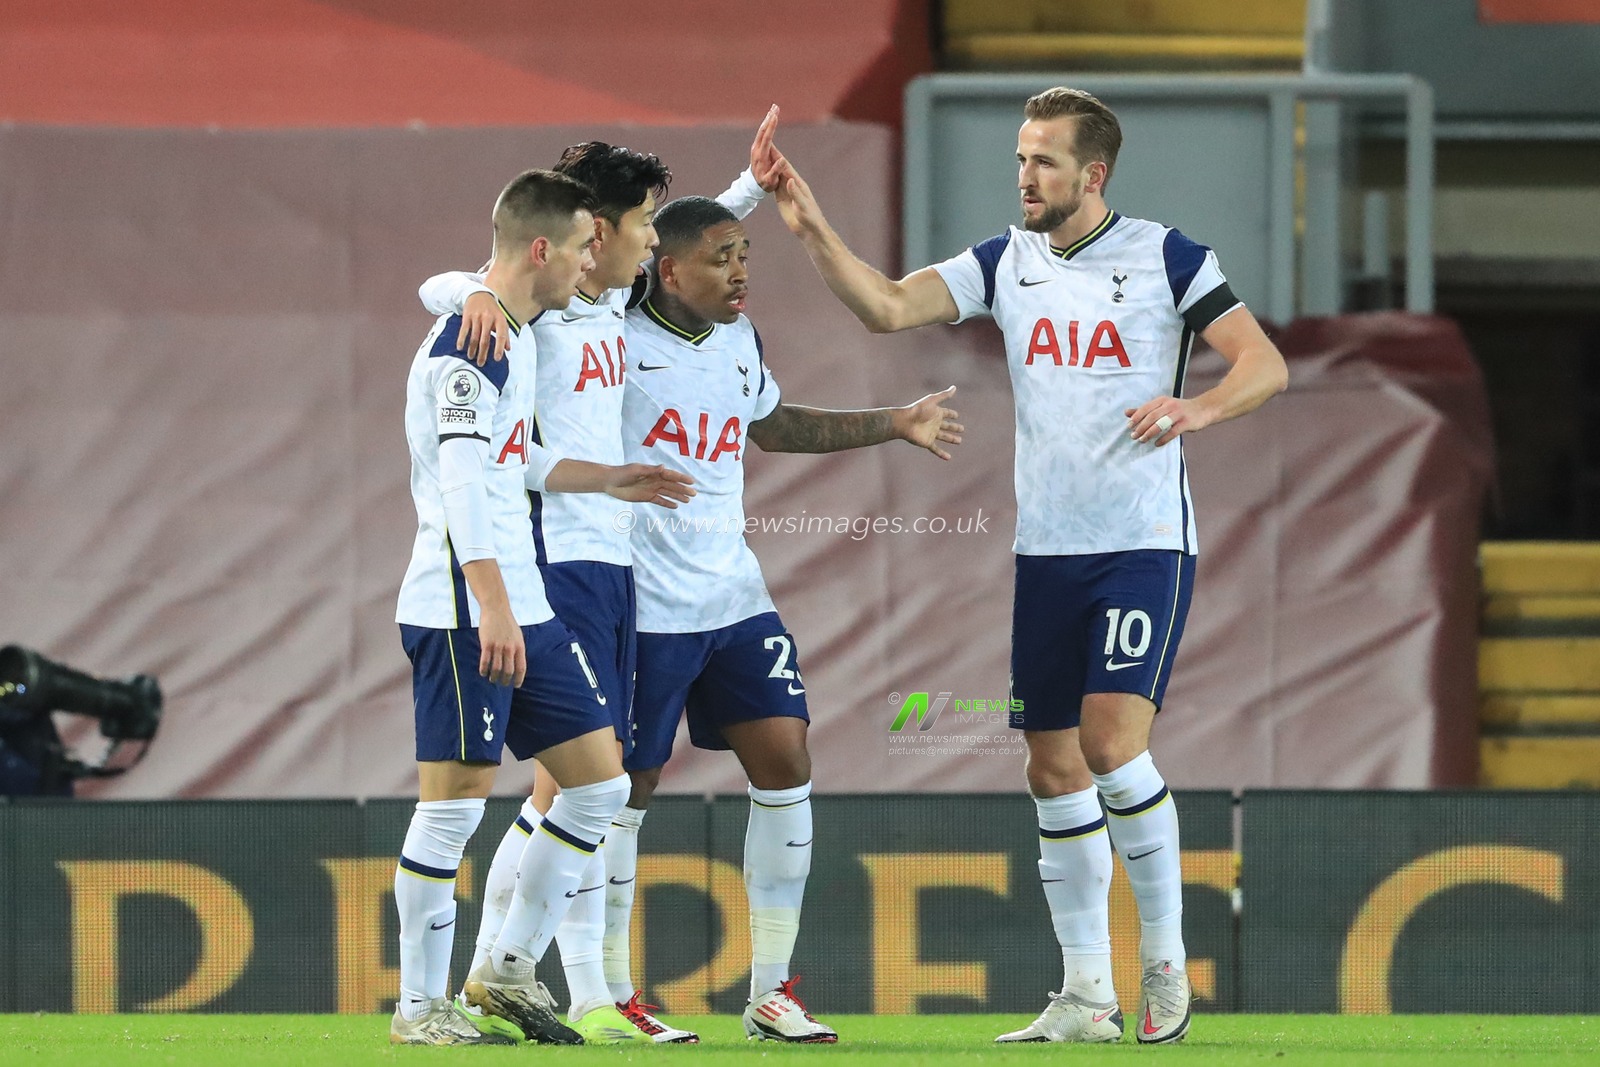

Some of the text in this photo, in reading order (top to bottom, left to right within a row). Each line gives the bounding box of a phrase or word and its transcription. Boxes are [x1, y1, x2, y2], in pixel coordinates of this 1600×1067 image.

[1025, 317, 1131, 367] AIA
[450, 409, 473, 418] room
[642, 408, 741, 462] AIA
[1104, 608, 1152, 658] 10
[764, 635, 802, 683] 2
